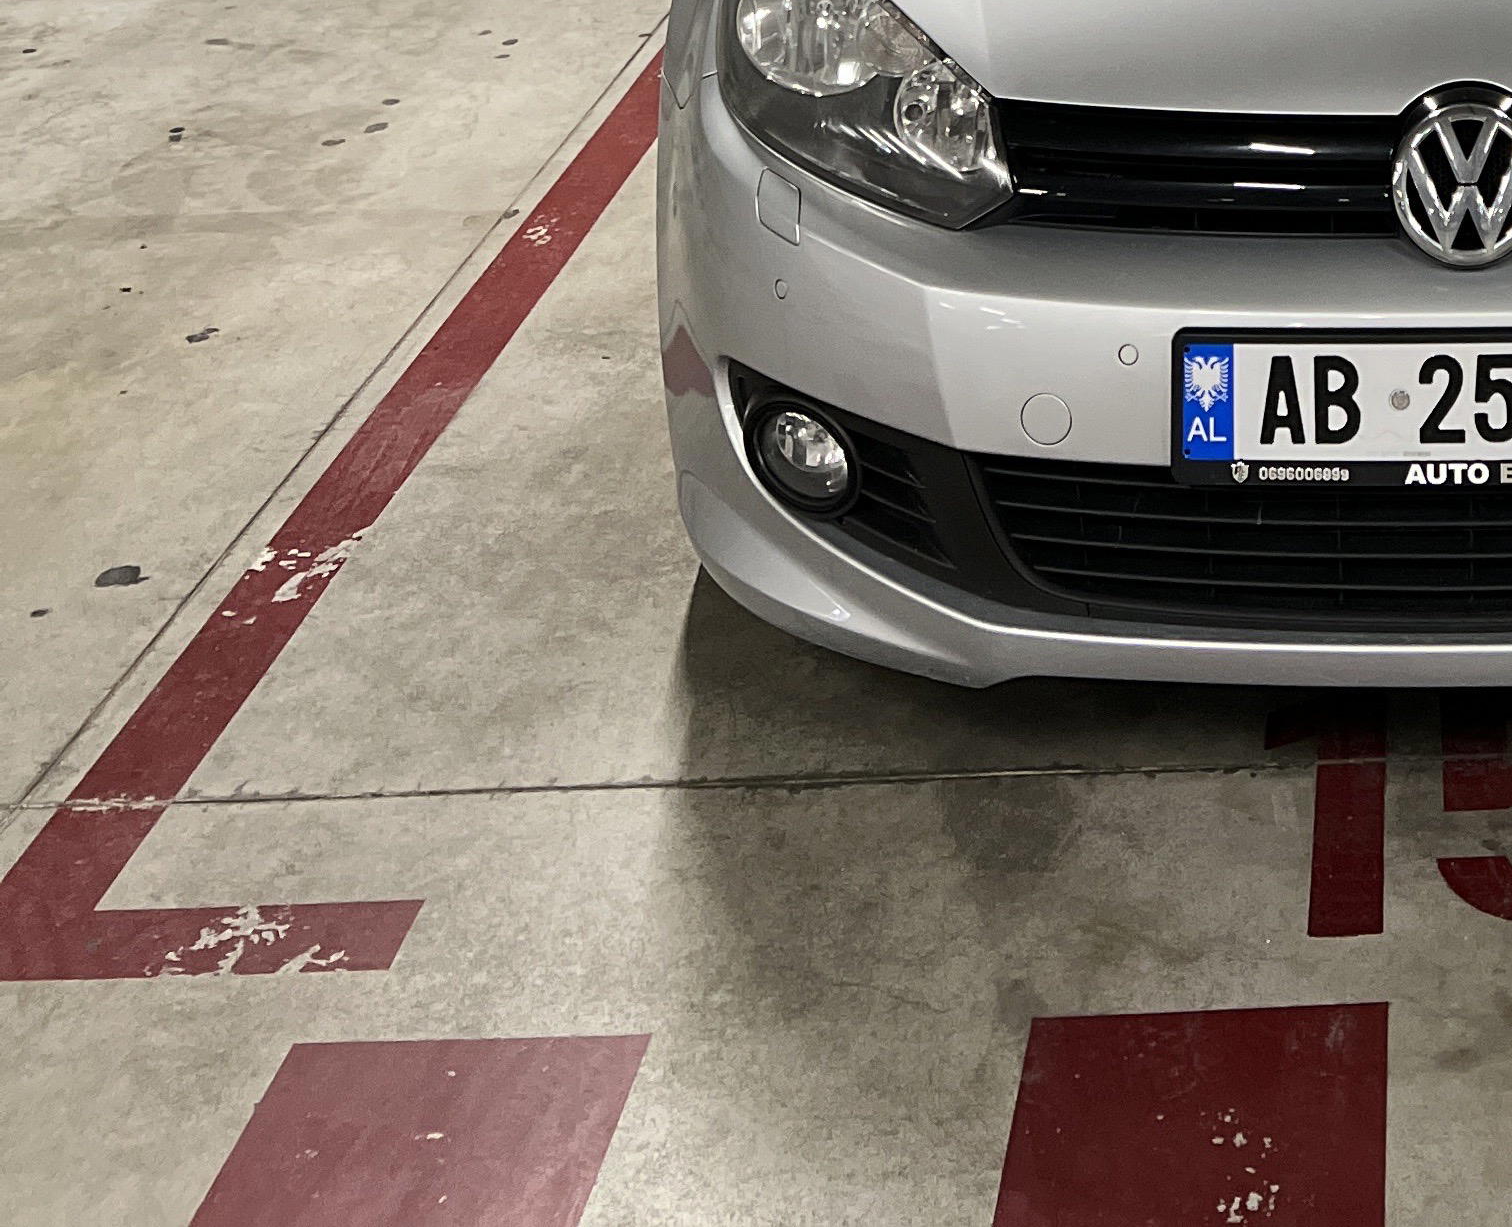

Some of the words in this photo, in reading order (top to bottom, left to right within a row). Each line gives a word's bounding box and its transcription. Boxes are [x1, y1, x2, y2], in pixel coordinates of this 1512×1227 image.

[1259, 355, 1361, 445] AB
[1187, 417, 1227, 442] AL
[1405, 463, 1490, 485] AUTO
